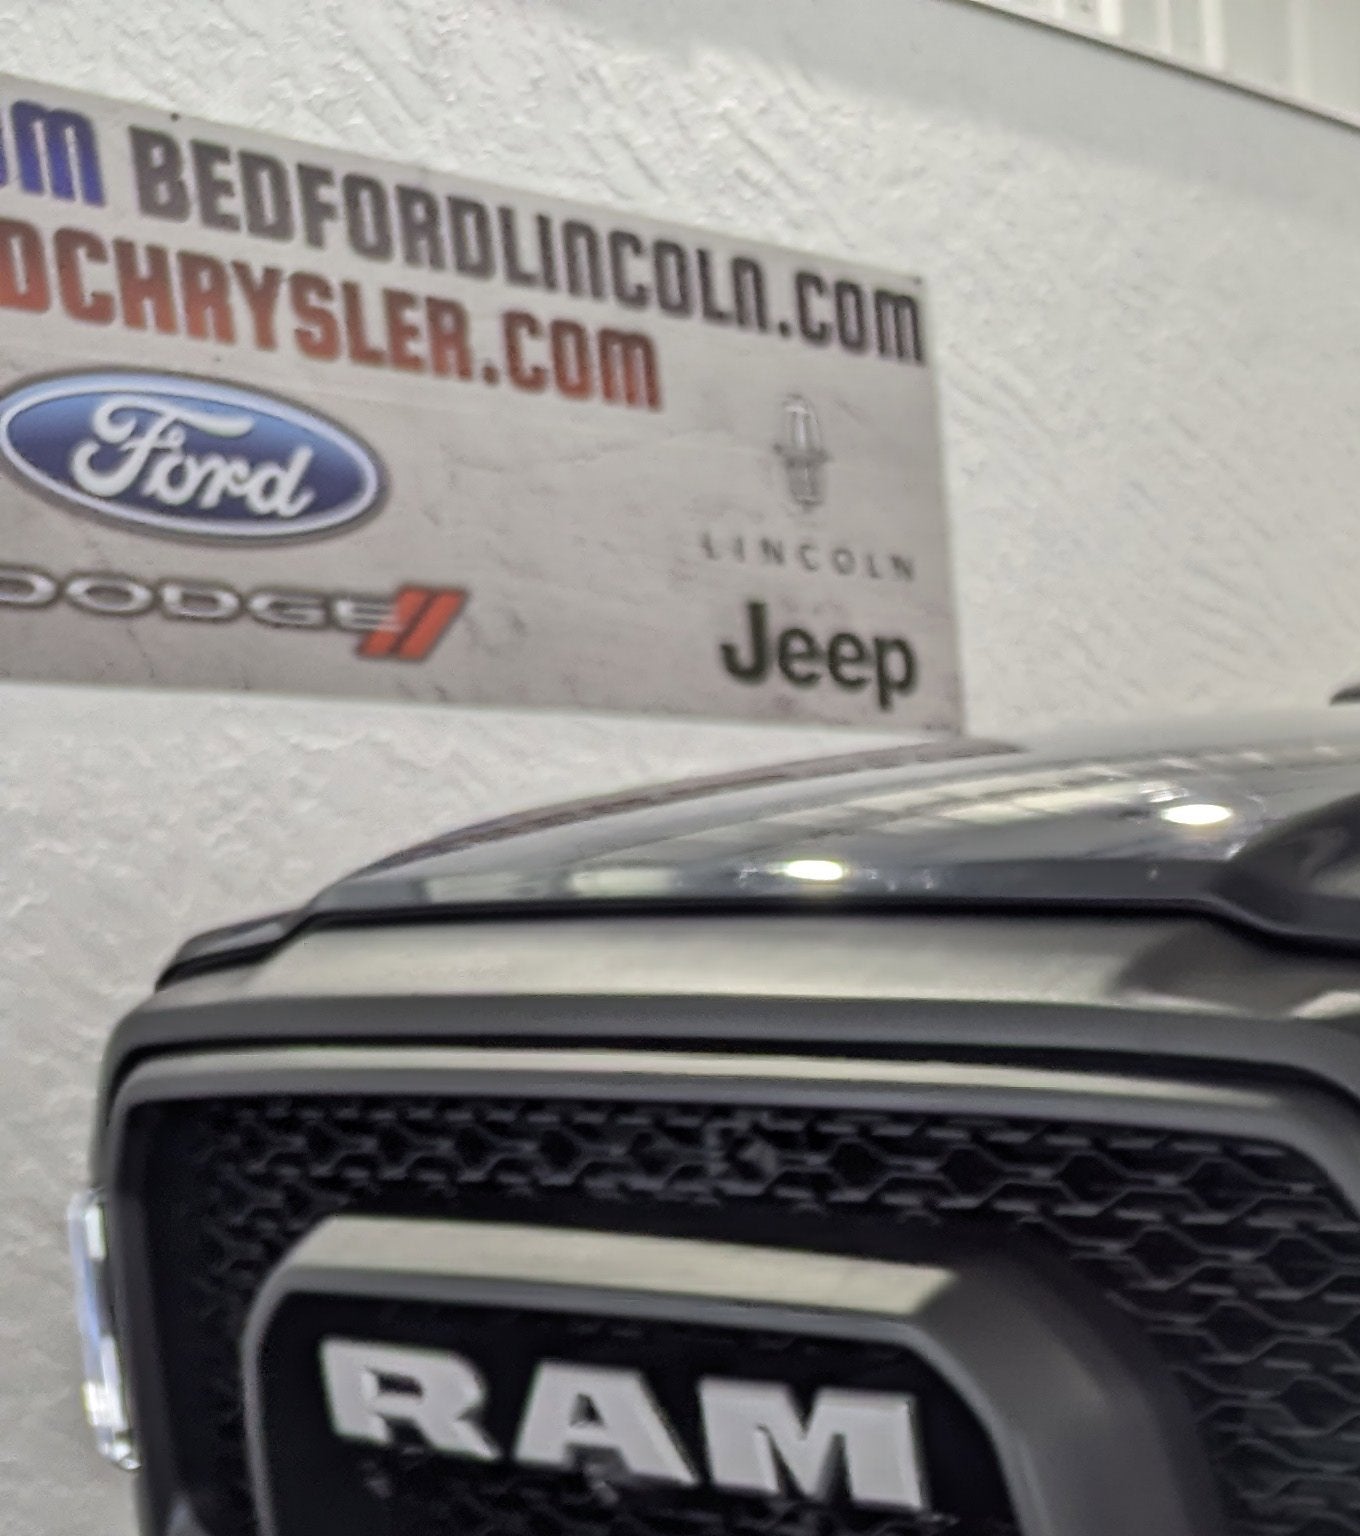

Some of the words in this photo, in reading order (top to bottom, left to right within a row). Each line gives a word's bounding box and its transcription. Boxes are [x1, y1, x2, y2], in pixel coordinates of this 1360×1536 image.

[70, 394, 316, 520] Ford
[701, 530, 914, 582] LINCOLN
[718, 598, 918, 710] Jeep
[319, 1337, 926, 1510] RAM
